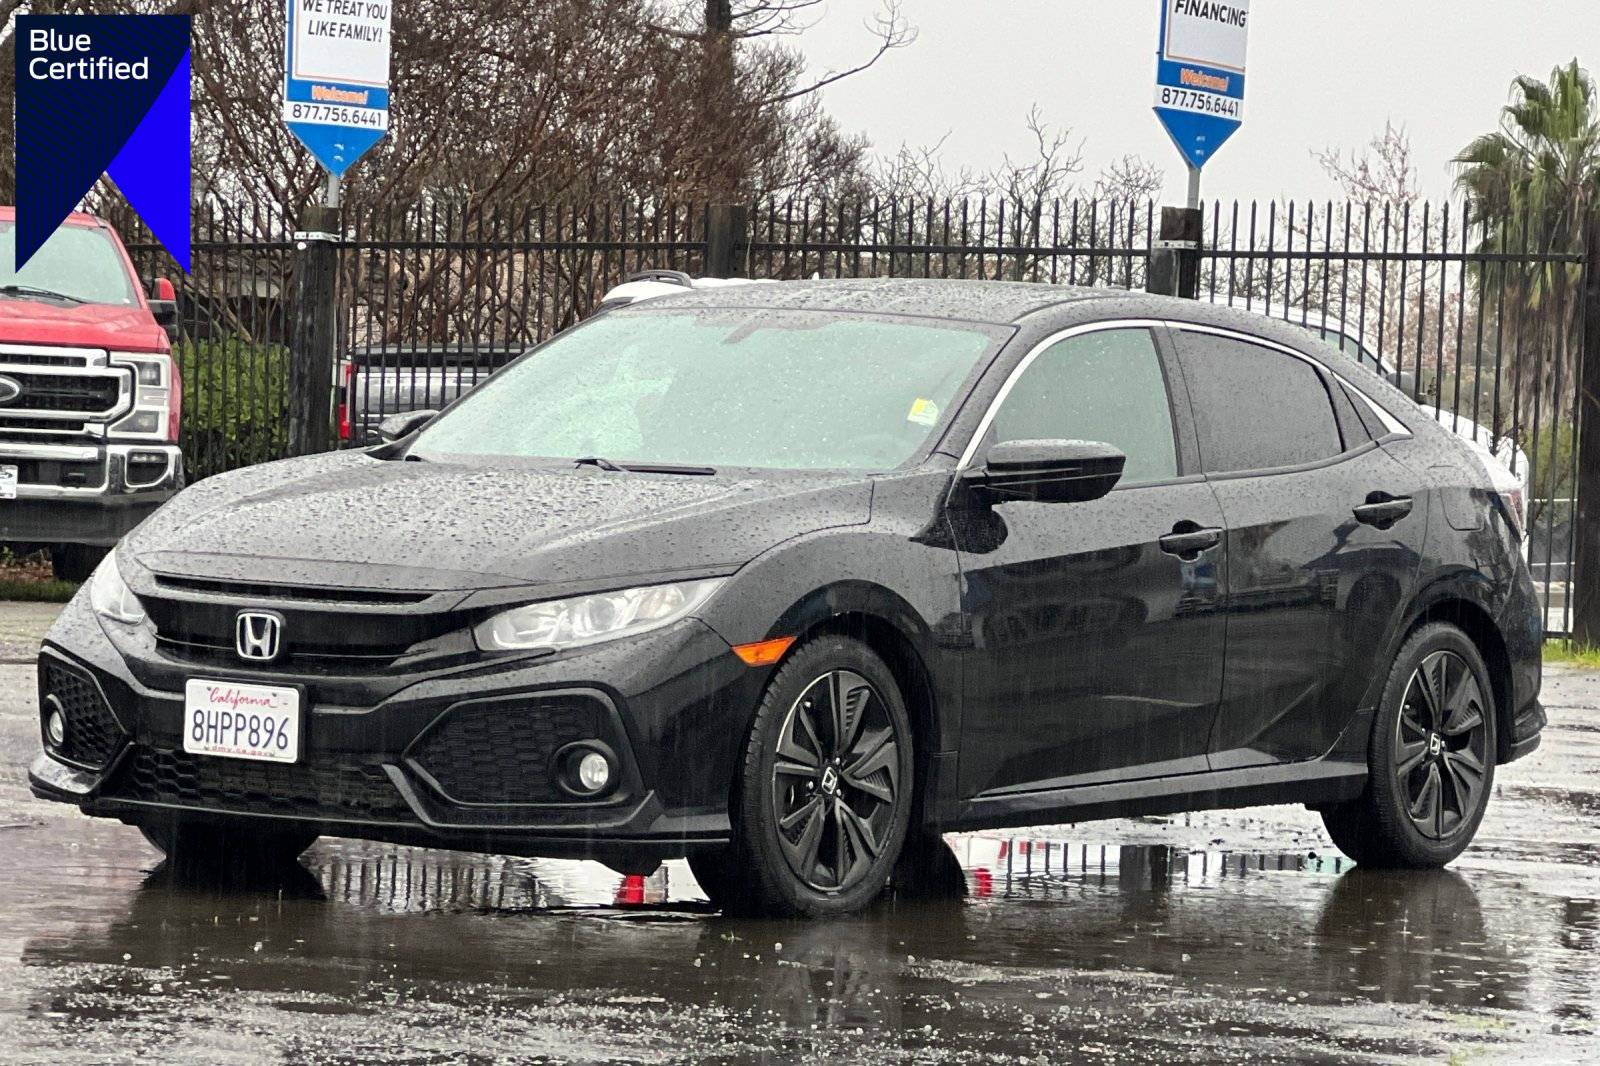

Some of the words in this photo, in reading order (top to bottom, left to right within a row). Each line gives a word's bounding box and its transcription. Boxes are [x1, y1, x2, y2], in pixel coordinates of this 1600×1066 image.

[303, 0, 322, 12] WE
[325, 0, 364, 17] TREAT
[366, 3, 387, 20] YOU
[1174, 0, 1247, 28] FINANCING
[308, 20, 337, 37] LIKE
[339, 23, 382, 43] FAMILY!
[311, 85, 368, 105] Welcome!
[1161, 88, 1239, 117] 877.756.6441
[292, 104, 382, 127] 877.756.6441
[210, 687, 279, 710] California
[192, 709, 289, 750] 8HPP896
[211, 745, 271, 756] dmv.ca.gov
